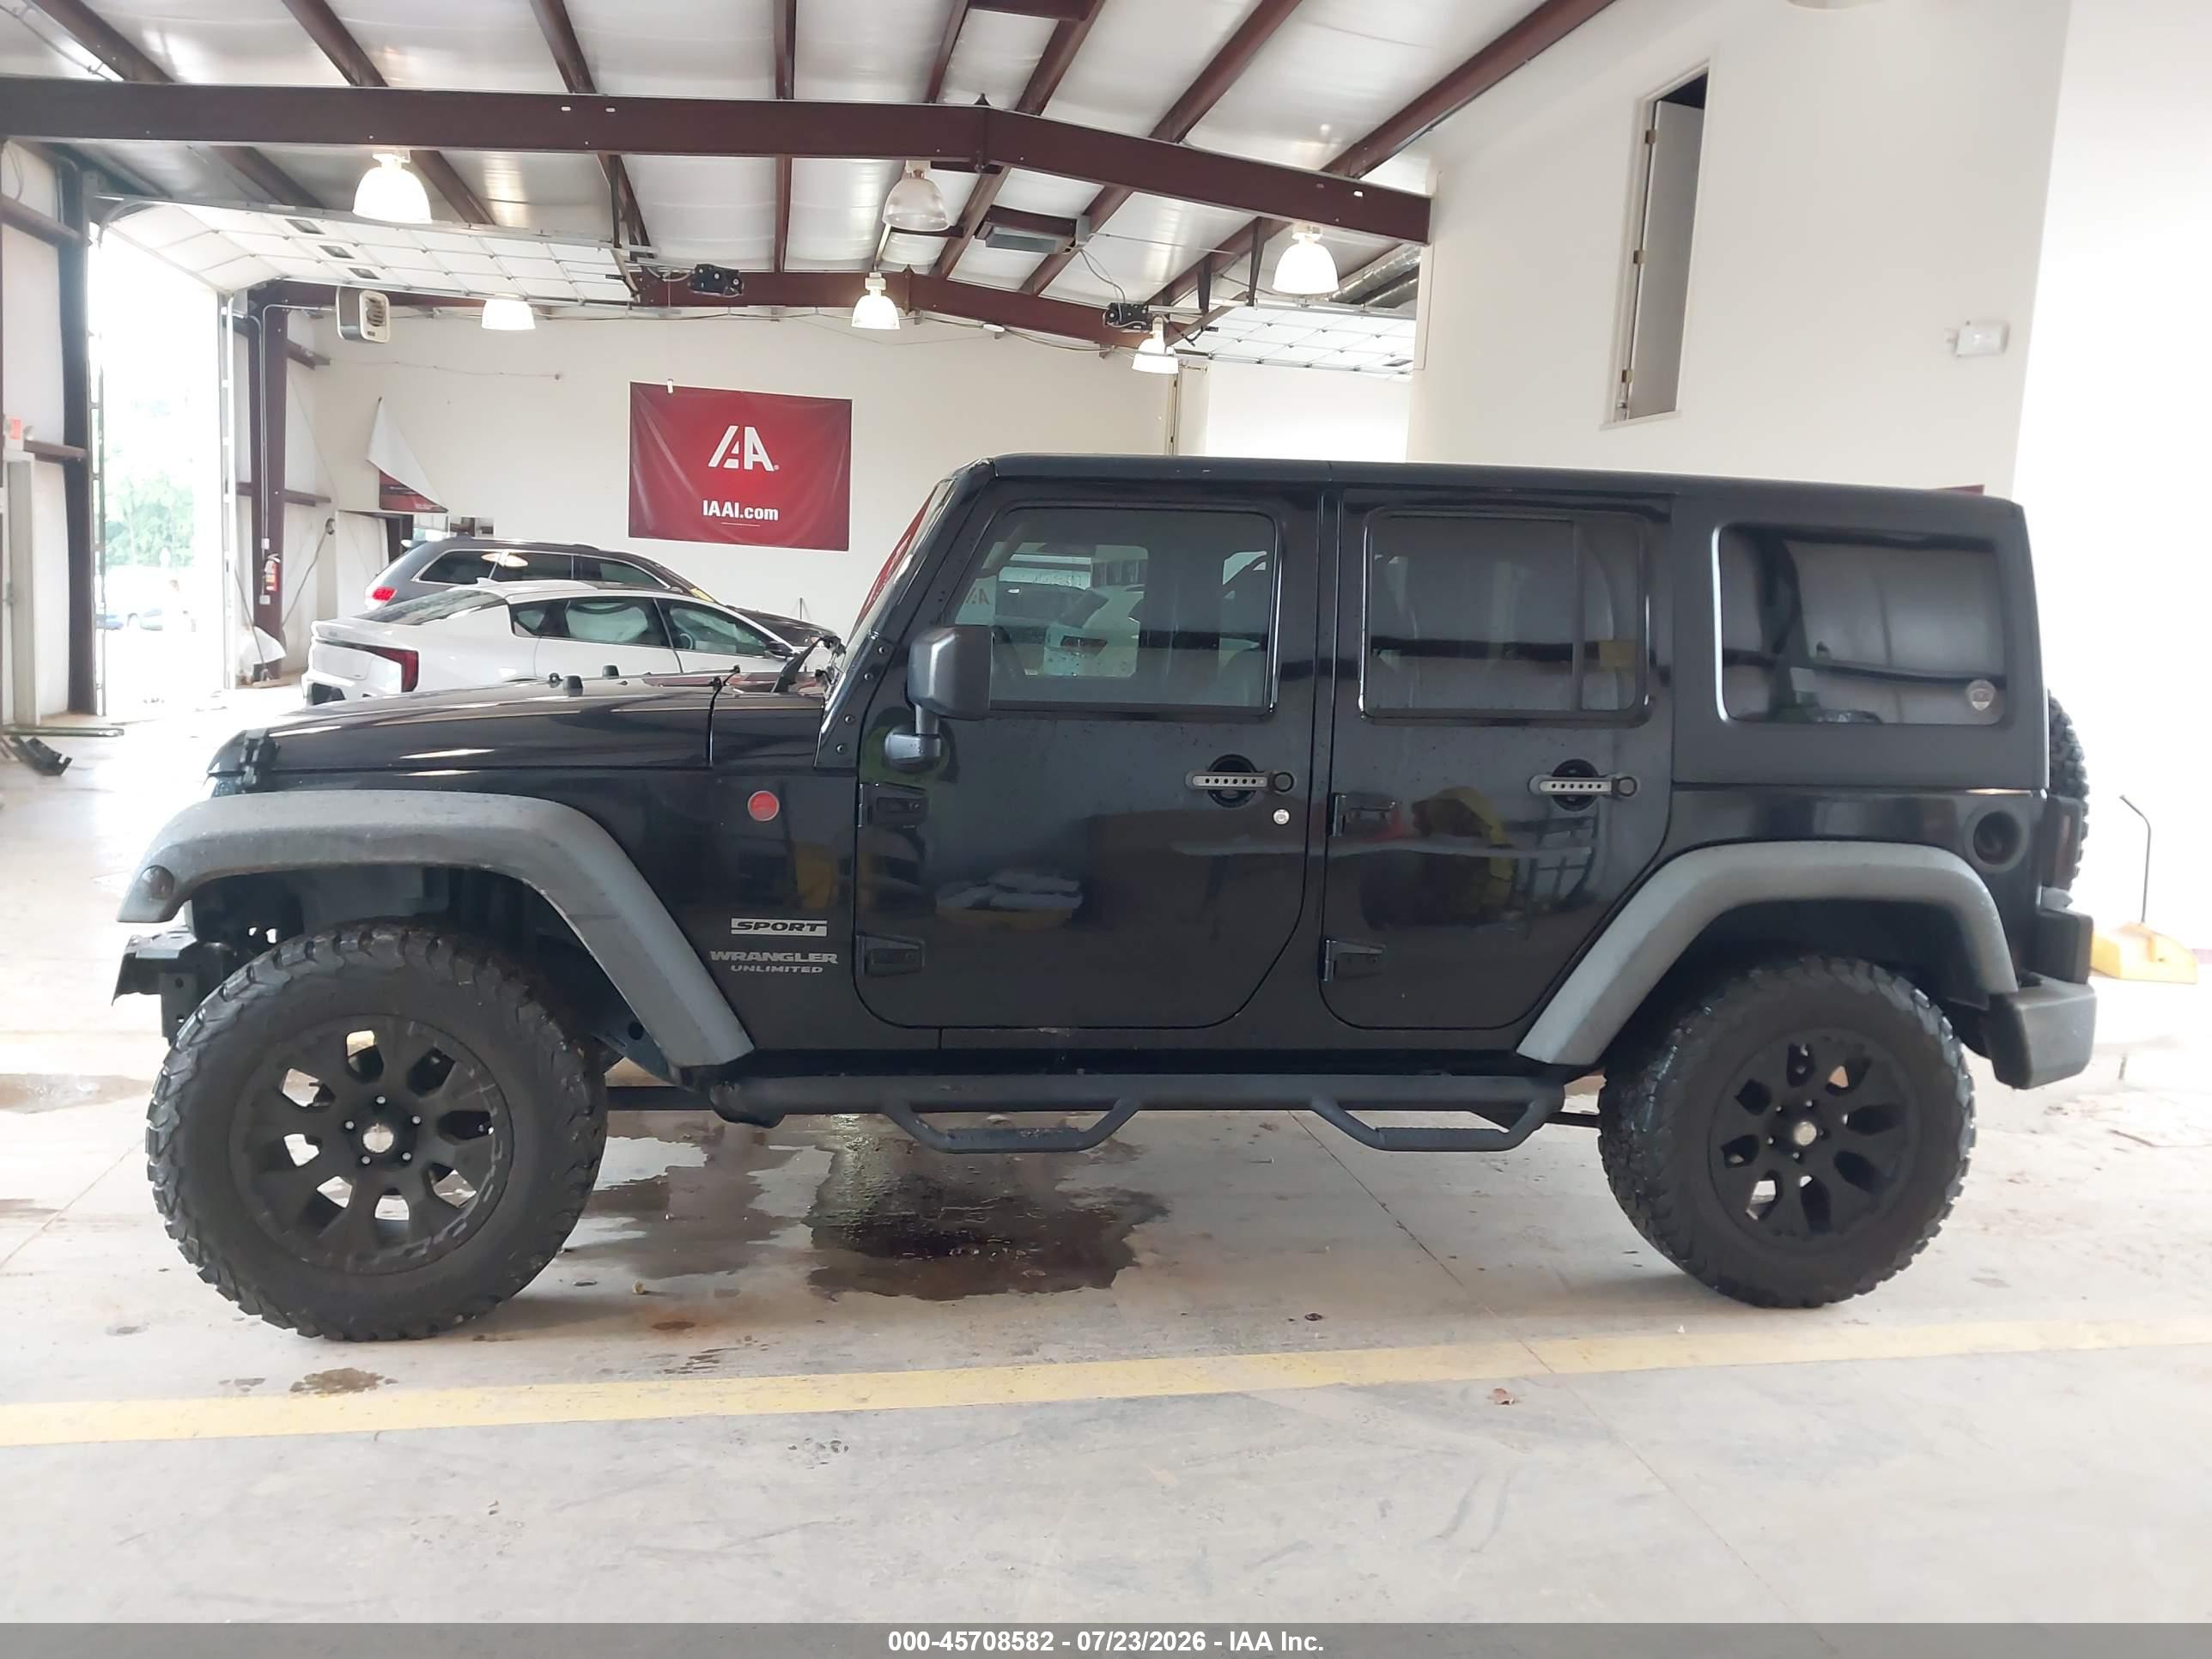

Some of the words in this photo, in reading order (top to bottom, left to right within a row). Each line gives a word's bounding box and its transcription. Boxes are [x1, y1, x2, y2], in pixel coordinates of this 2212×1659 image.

[702, 500, 779, 521] IAAI.com
[732, 920, 826, 933] SPORT
[709, 951, 838, 963] WRANGLER
[730, 964, 823, 973] UNLIMITED
